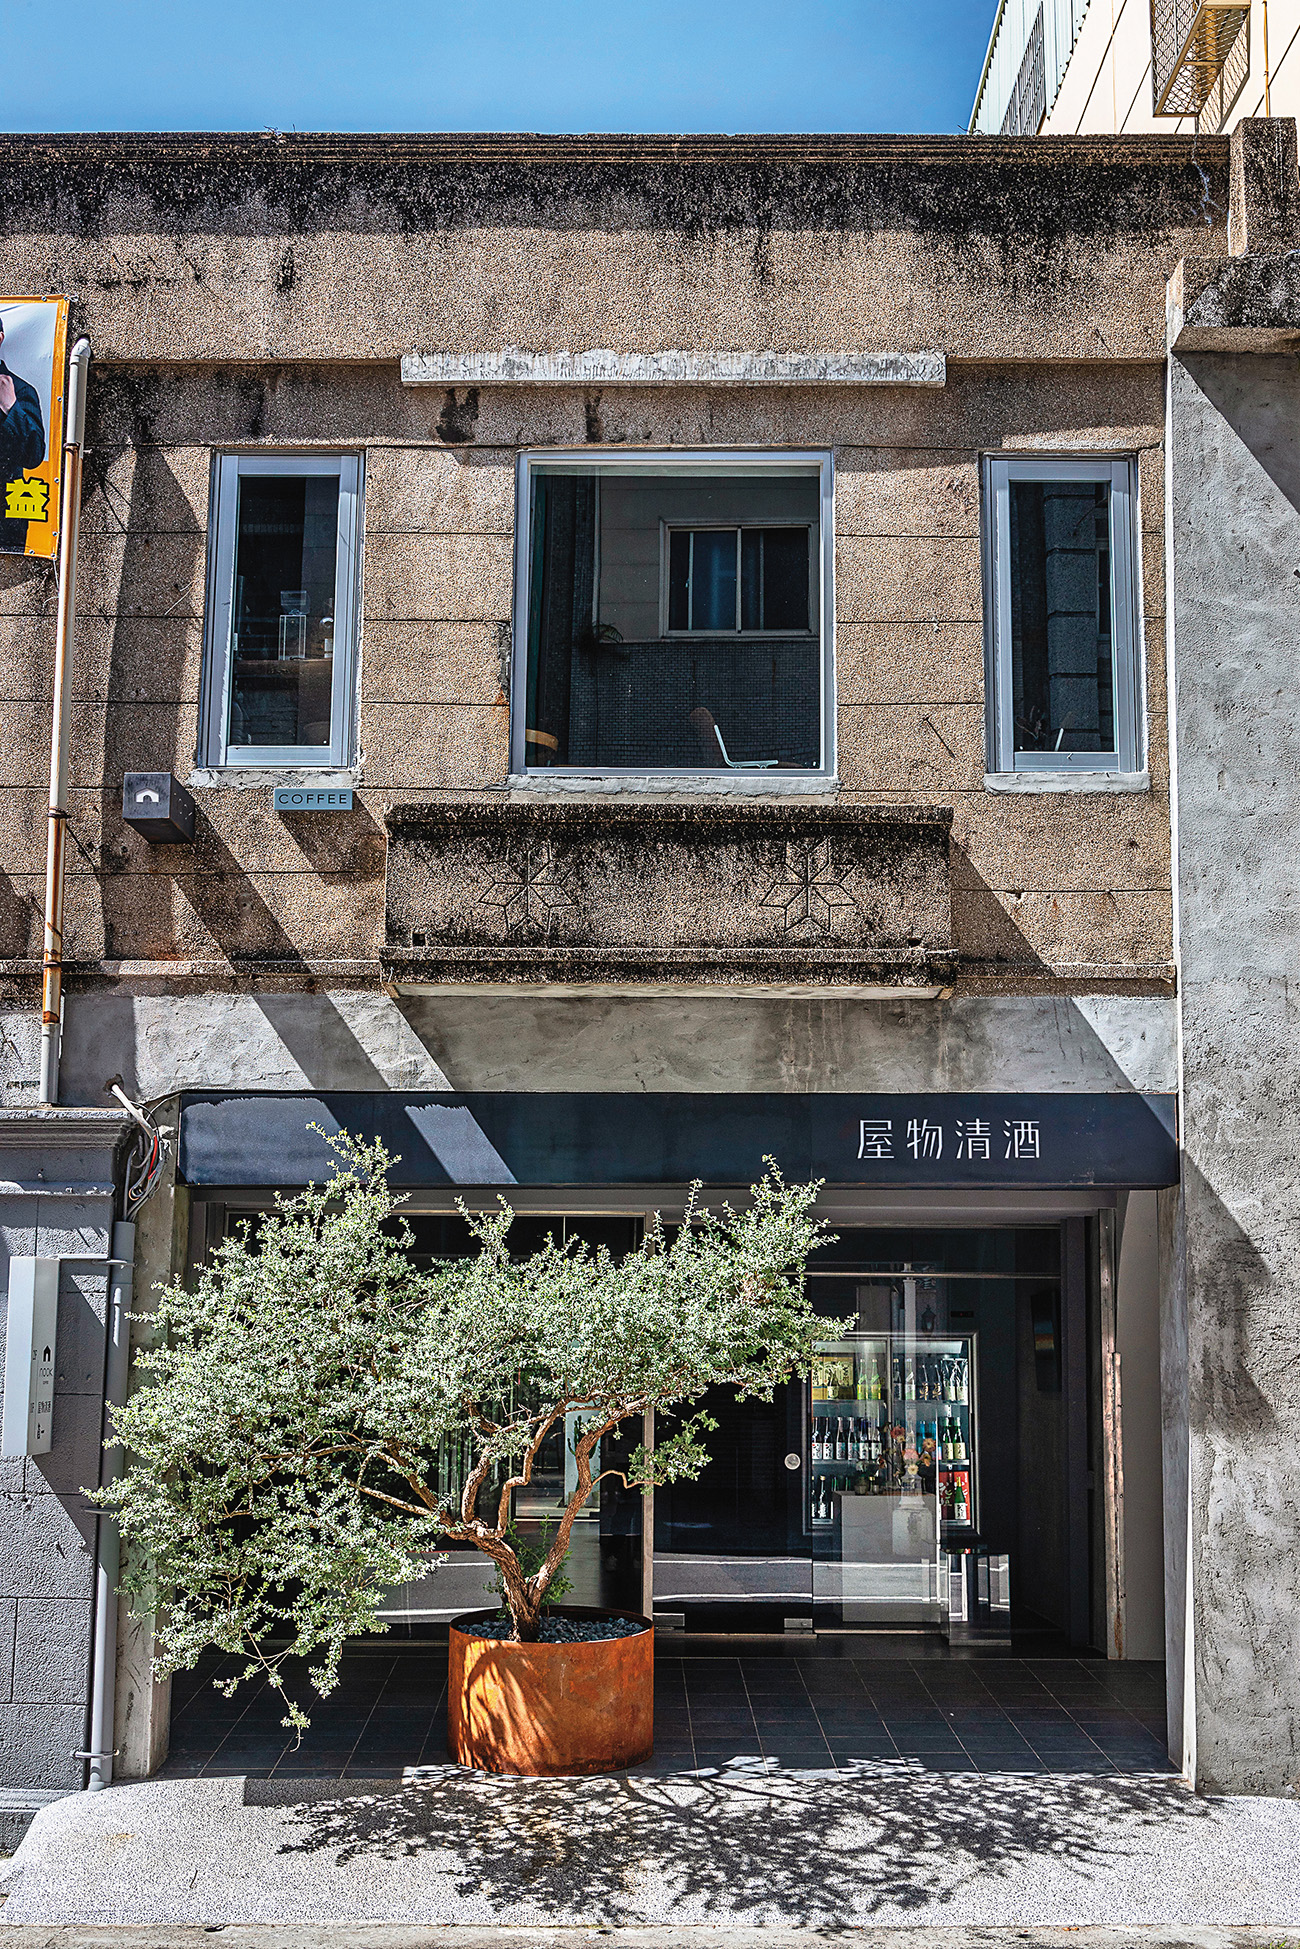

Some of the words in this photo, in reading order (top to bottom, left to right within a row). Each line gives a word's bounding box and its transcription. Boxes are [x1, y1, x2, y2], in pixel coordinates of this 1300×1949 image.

[4, 478, 48, 521] 益
[278, 793, 347, 804] COFFEE
[857, 1118, 1040, 1160] 屋物清酒
